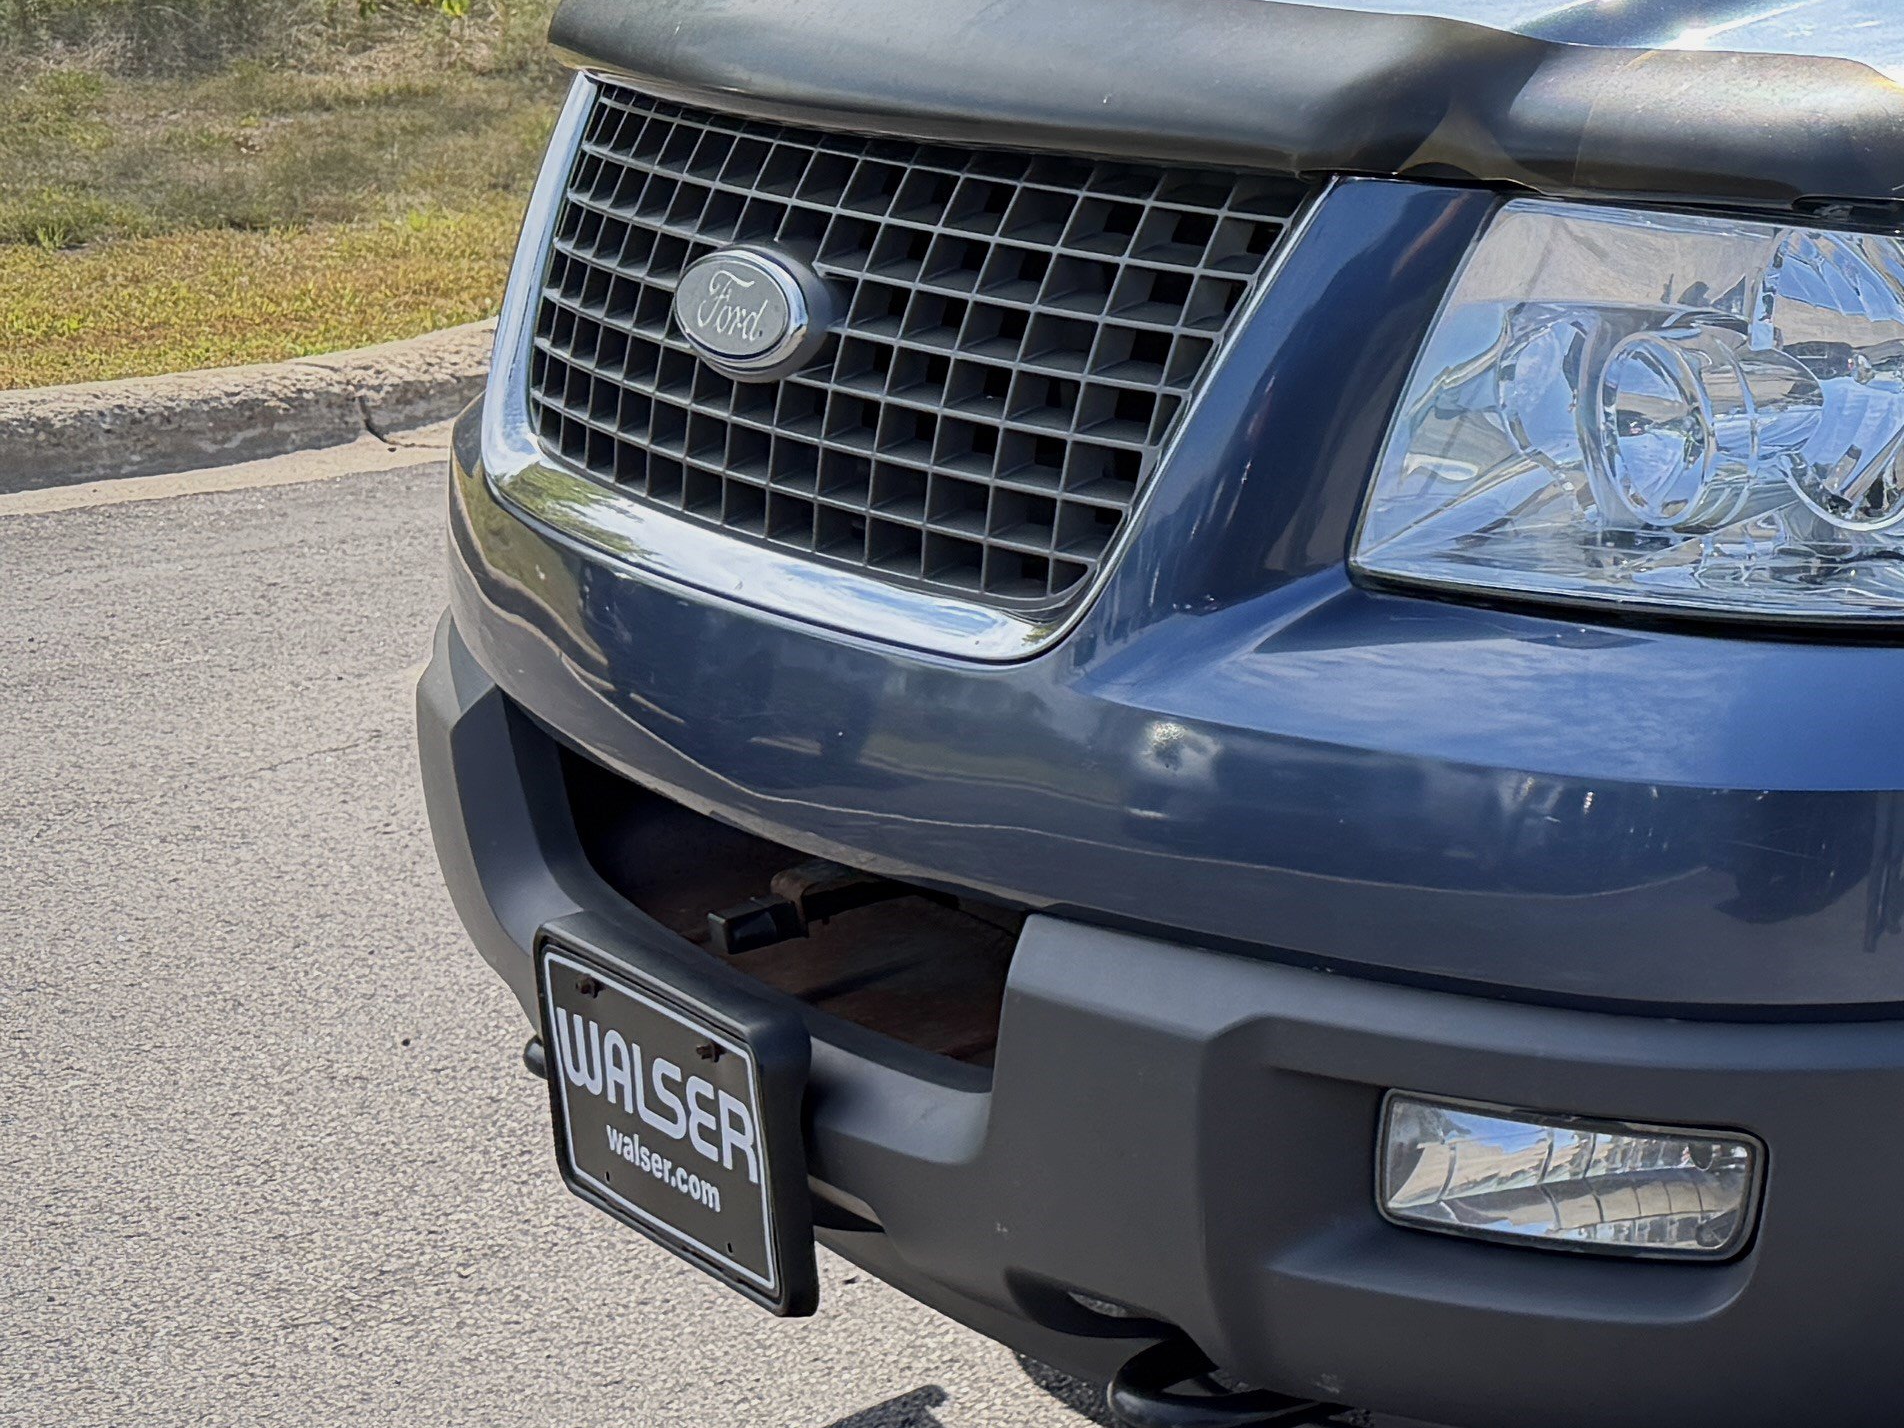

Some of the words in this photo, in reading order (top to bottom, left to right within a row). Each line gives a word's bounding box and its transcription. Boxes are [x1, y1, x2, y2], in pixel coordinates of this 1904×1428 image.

[698, 270, 769, 342] Ford
[556, 1007, 759, 1185] WALSER
[606, 1124, 721, 1213] walser.com
